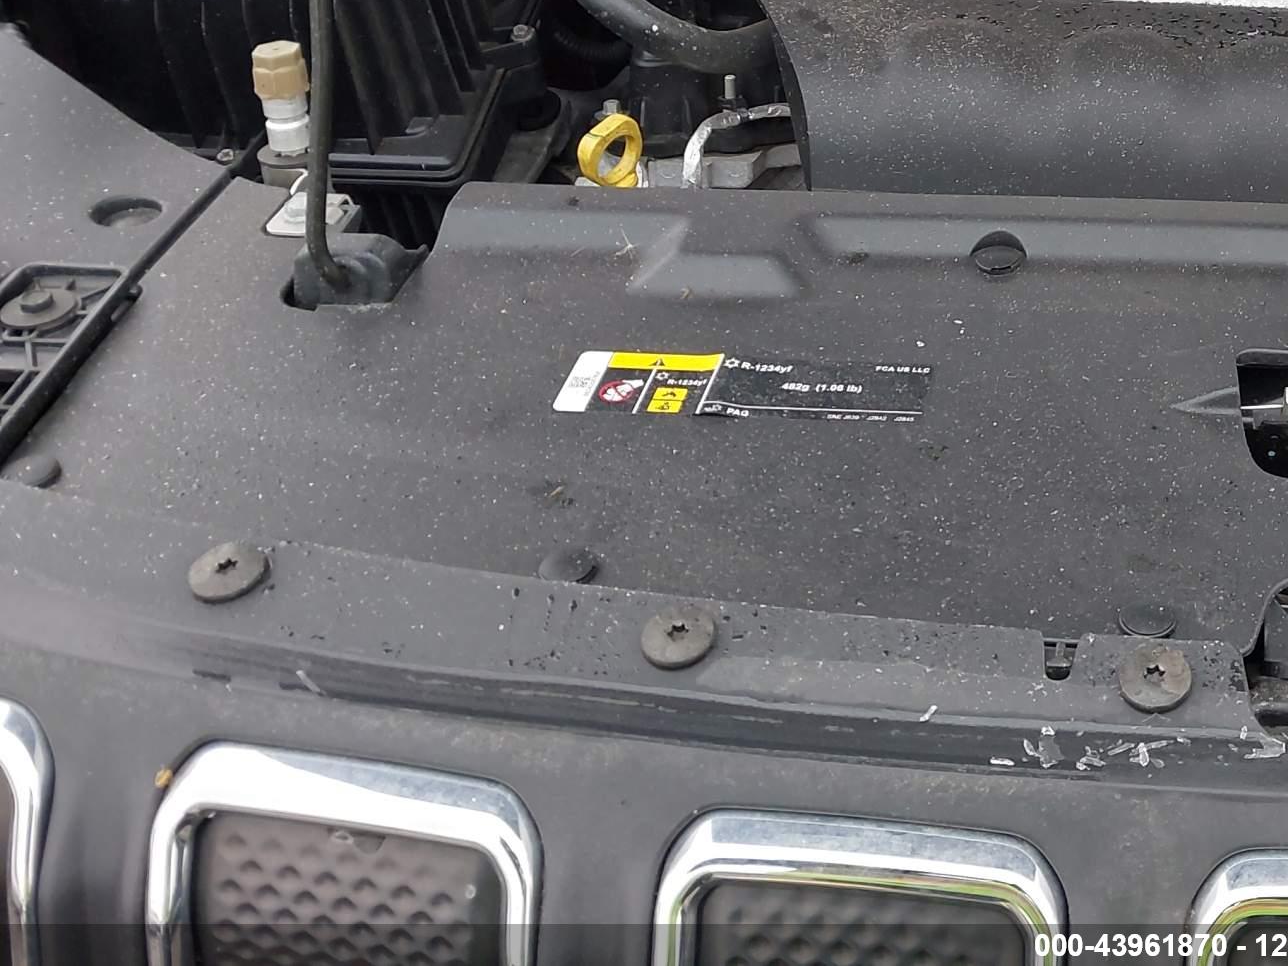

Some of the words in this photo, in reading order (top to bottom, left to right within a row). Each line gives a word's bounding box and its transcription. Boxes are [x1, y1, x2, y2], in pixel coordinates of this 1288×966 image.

[741, 361, 794, 374] R-1234yf
[781, 382, 811, 392] 482g
[846, 384, 863, 394] lb)
